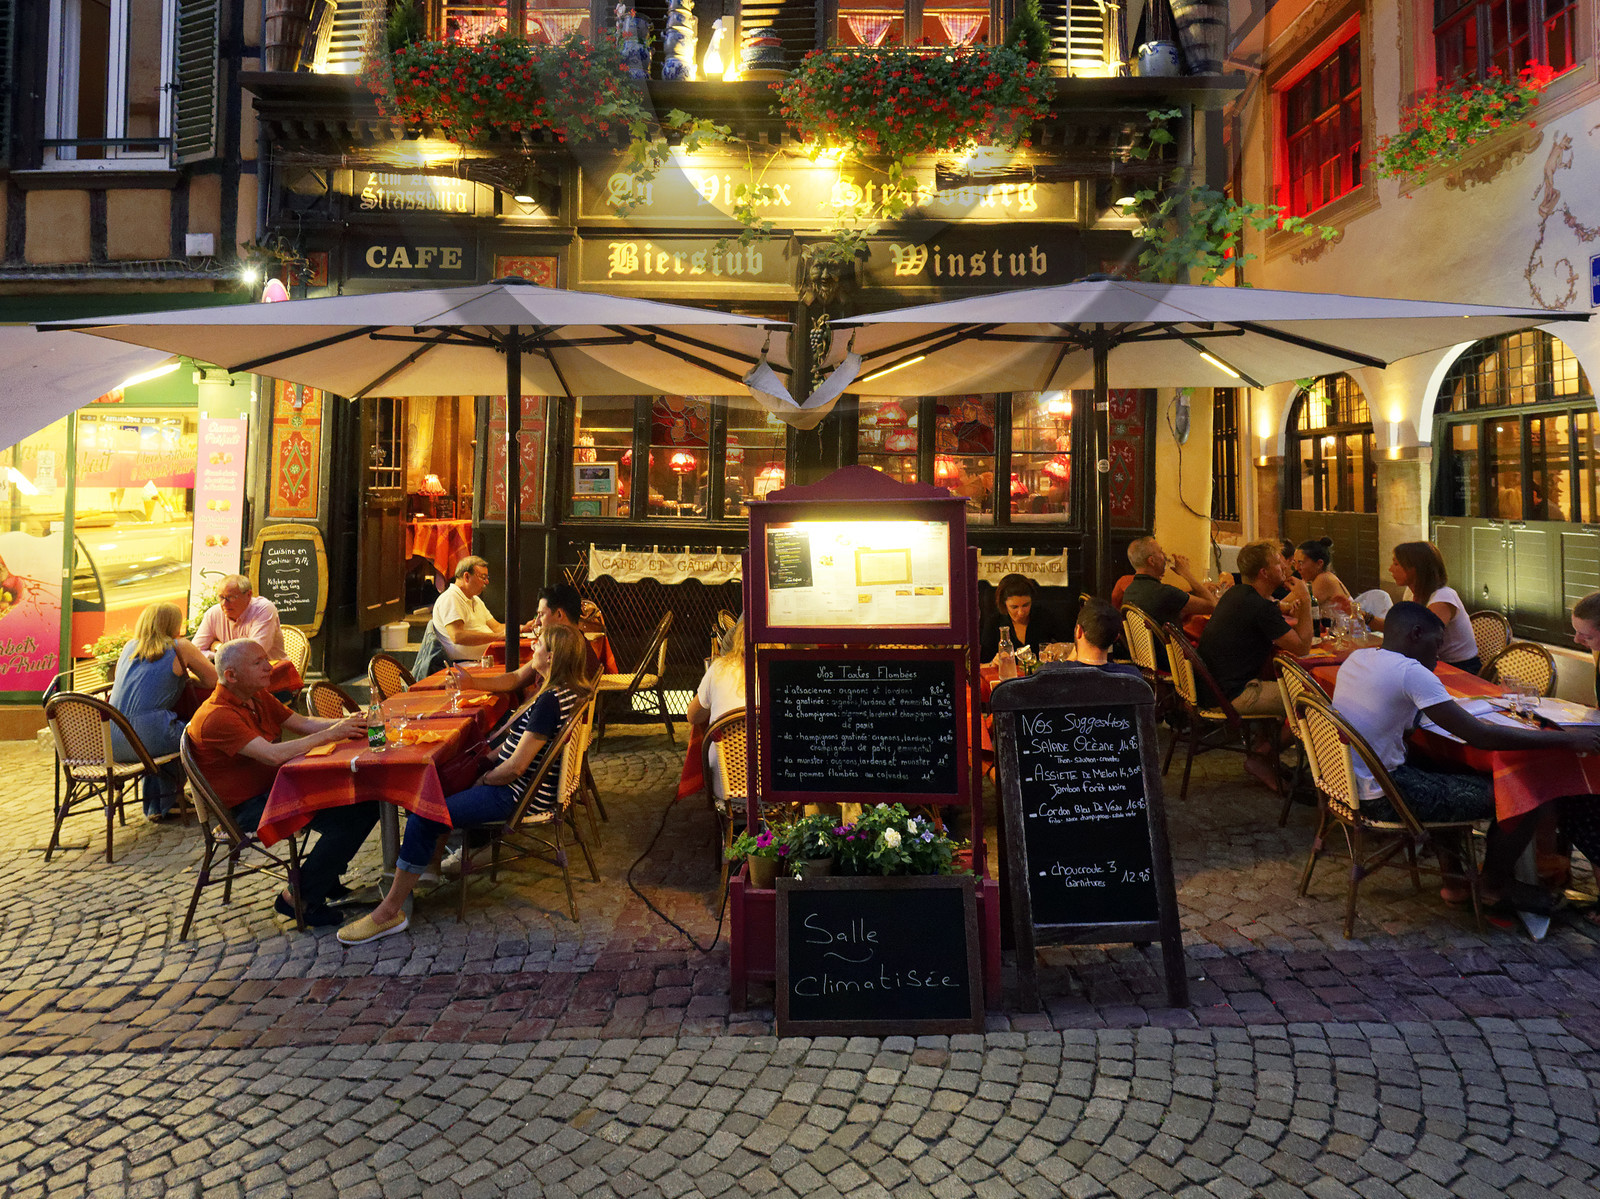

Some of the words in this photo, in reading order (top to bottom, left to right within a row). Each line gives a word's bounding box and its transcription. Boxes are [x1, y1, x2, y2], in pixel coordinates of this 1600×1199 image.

[360, 187, 468, 212] Strassburg
[365, 246, 463, 270] CAFE
[607, 241, 764, 280] Bierstub
[889, 242, 1048, 278] Winstub
[268, 548, 296, 556] Cuisine
[601, 557, 637, 570] CAFÉ
[649, 560, 664, 571] ET
[677, 558, 741, 572] GÂTEAUX
[984, 562, 1065, 574] TRADITIONNEL
[816, 665, 834, 679] Nos
[838, 665, 870, 679] Tartes
[877, 666, 918, 680] Flambées
[841, 721, 852, 729] de
[1022, 712, 1053, 736] Nos
[1061, 712, 1131, 735] Suggestions
[796, 732, 839, 746] hampignons
[1049, 783, 1081, 800] Jambon
[1038, 802, 1071, 817] Cordon
[1074, 804, 1091, 814] Bleu
[1107, 861, 1117, 873] 3
[1065, 876, 1106, 888] Garnitures
[804, 913, 878, 944] Salle
[794, 963, 960, 997] Climatisée
